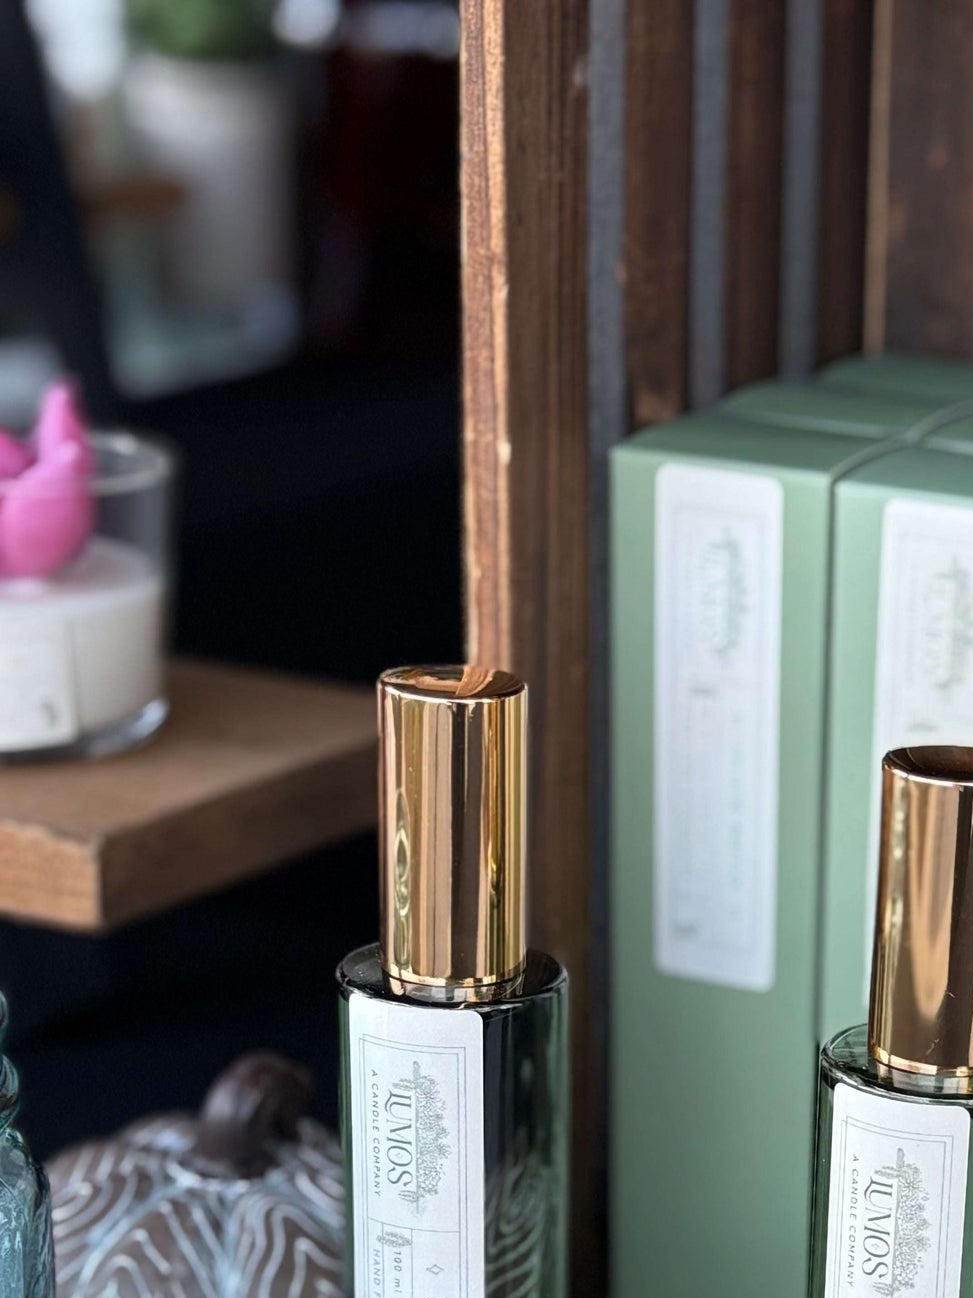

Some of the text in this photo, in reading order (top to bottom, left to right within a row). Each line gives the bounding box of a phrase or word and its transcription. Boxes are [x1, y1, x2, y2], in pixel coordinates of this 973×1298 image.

[372, 1083, 380, 1131] CANDLE
[385, 1090, 413, 1186] LUMOS
[373, 1138, 381, 1196] COMPANY
[850, 1169, 859, 1220] CANDLE
[862, 1176, 894, 1278] LUMOS
[373, 1249, 382, 1286] HAND
[394, 1250, 402, 1272] 100
[848, 1226, 856, 1288] COMPANY
